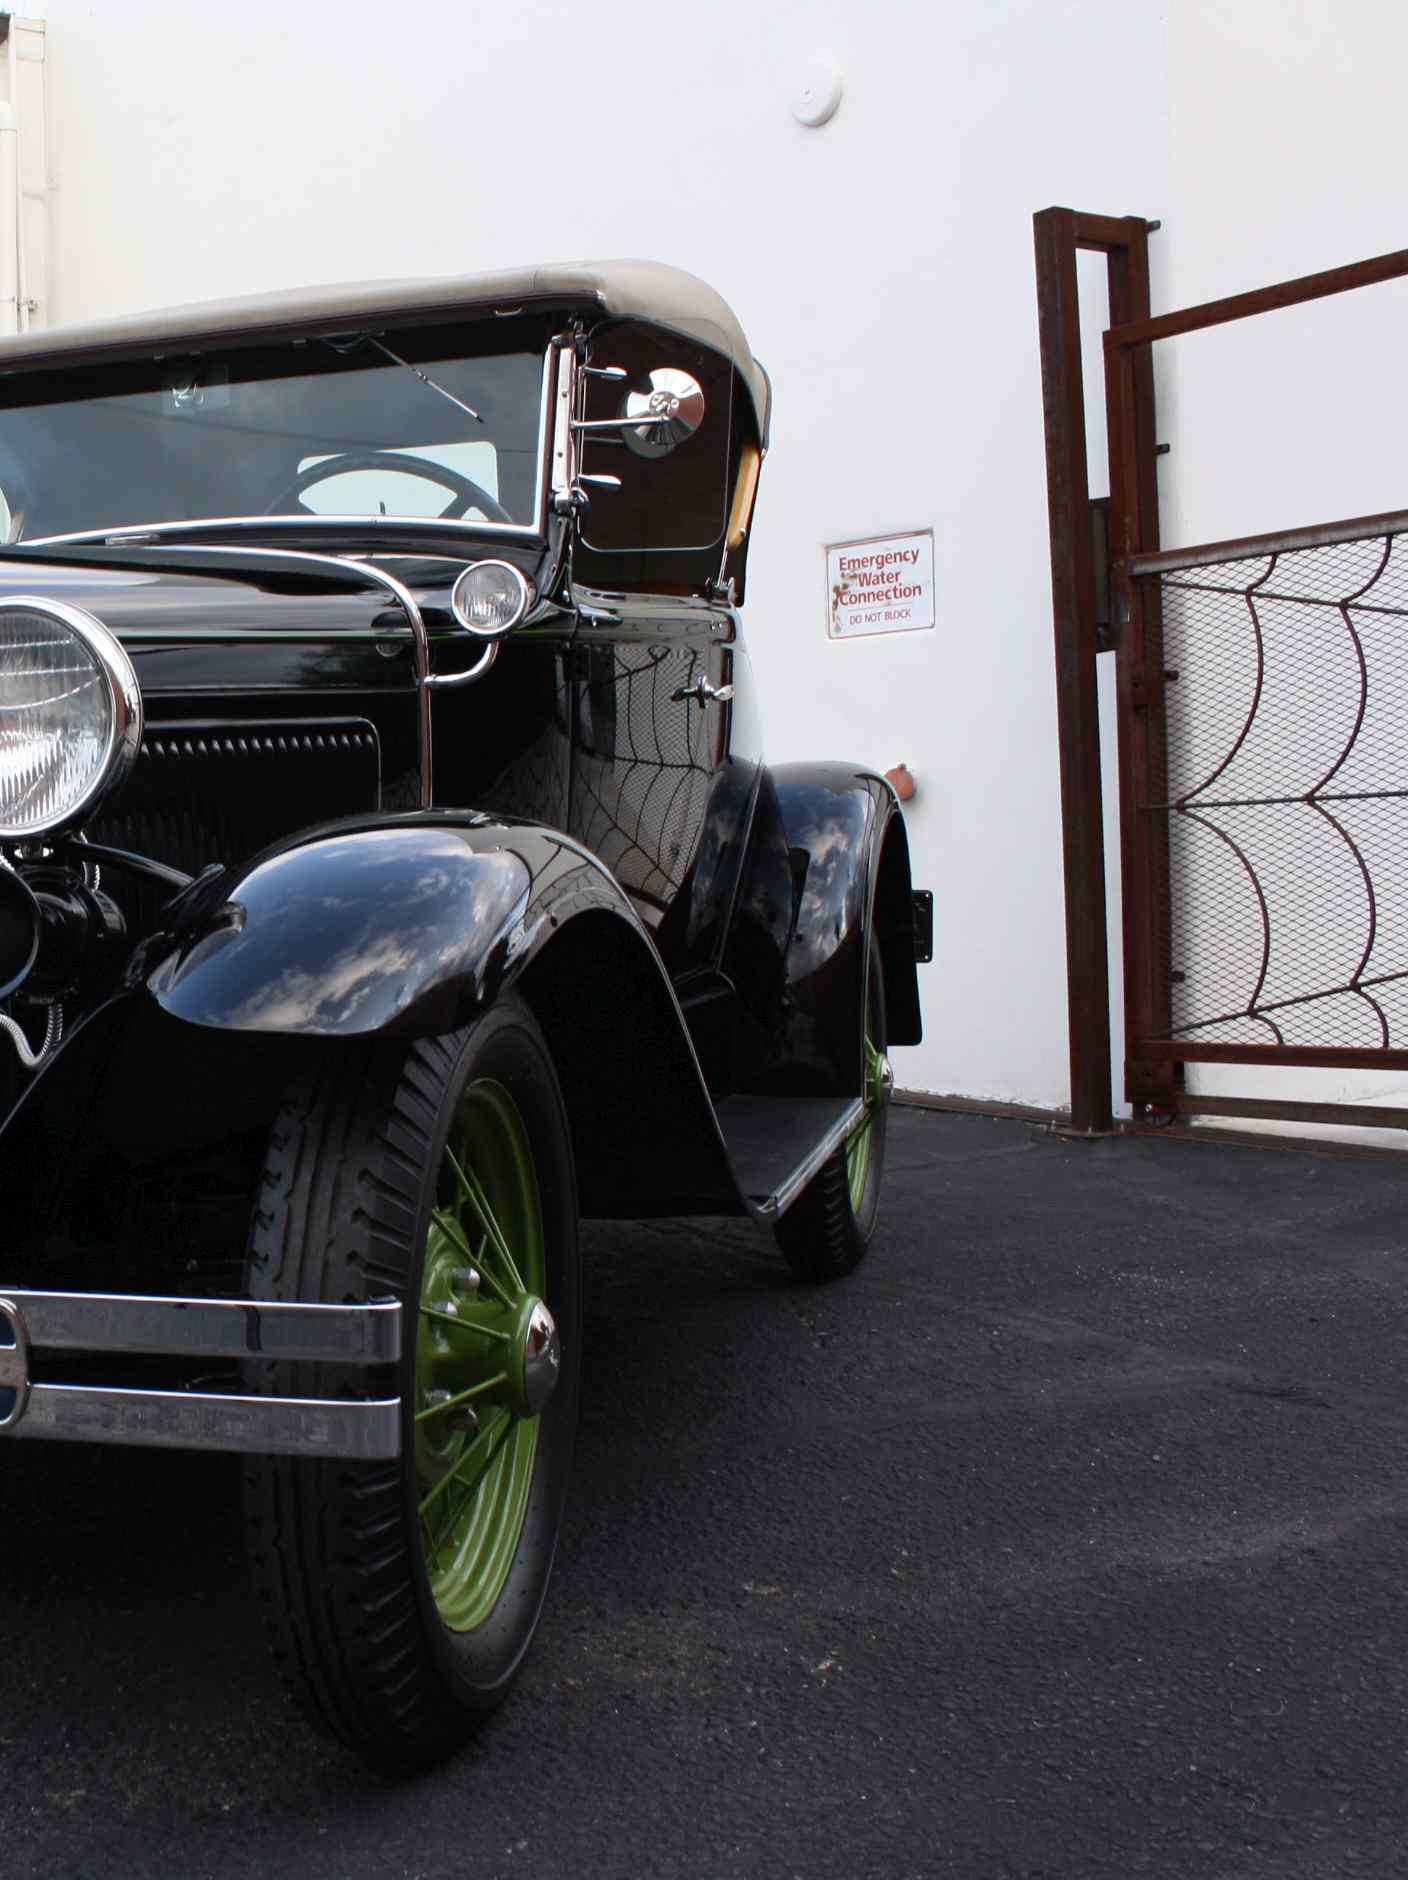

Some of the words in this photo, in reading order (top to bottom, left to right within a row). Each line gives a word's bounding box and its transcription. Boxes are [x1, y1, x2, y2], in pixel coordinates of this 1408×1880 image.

[839, 549, 919, 571] Emergency
[857, 571, 901, 587] Water
[839, 584, 922, 606] Connection
[849, 615, 862, 625] DO
[864, 611, 881, 623] NOT
[884, 608, 911, 620] BLOCK
